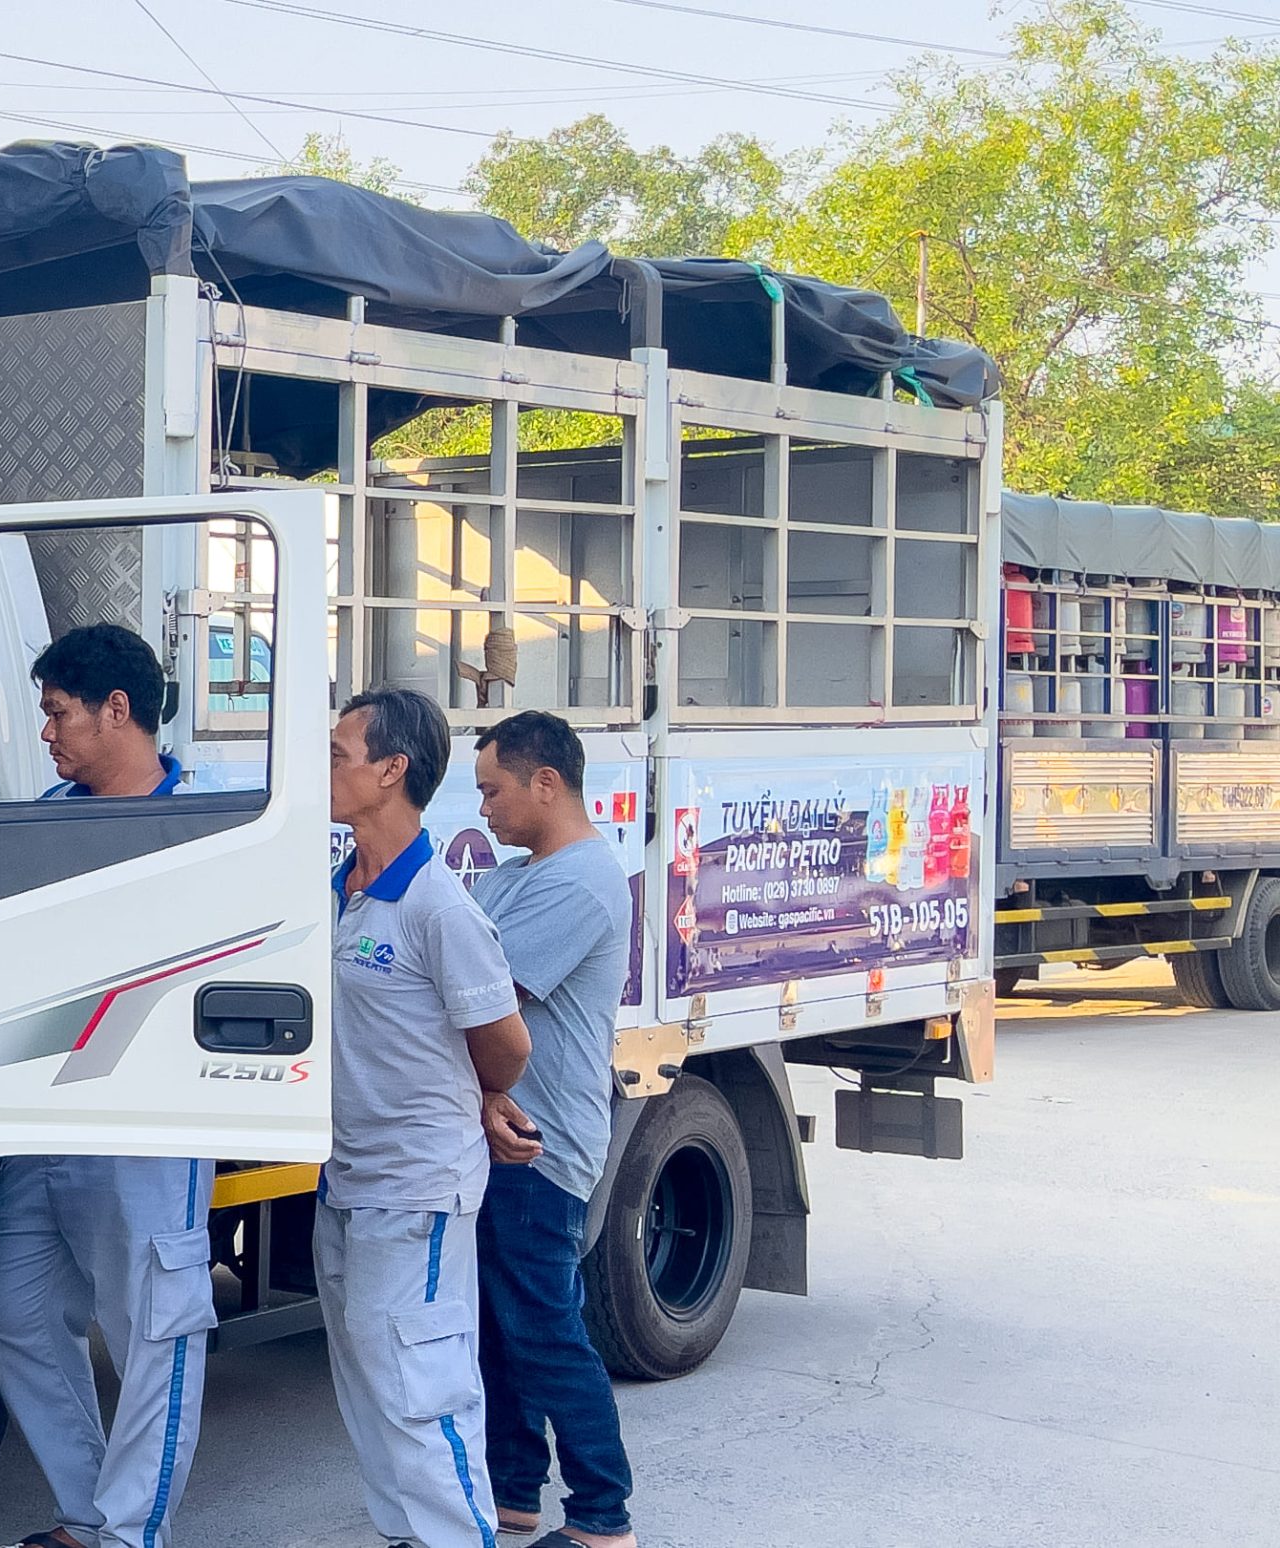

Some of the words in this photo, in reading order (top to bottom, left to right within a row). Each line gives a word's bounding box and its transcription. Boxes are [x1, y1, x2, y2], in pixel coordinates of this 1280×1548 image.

[722, 789, 784, 833] TUYỂN
[787, 799, 817, 838] ĐẠI
[824, 790, 846, 832] LÝ
[725, 843, 788, 873] PACIFIC
[789, 838, 841, 871] PETRO
[722, 884, 761, 903] Hotline:
[764, 880, 789, 903] (028)
[791, 878, 815, 898] 3730
[816, 876, 840, 895] 0897
[739, 911, 777, 929] Website:
[778, 907, 835, 929] gaspacific.vn
[869, 898, 968, 937] 51B-105.05
